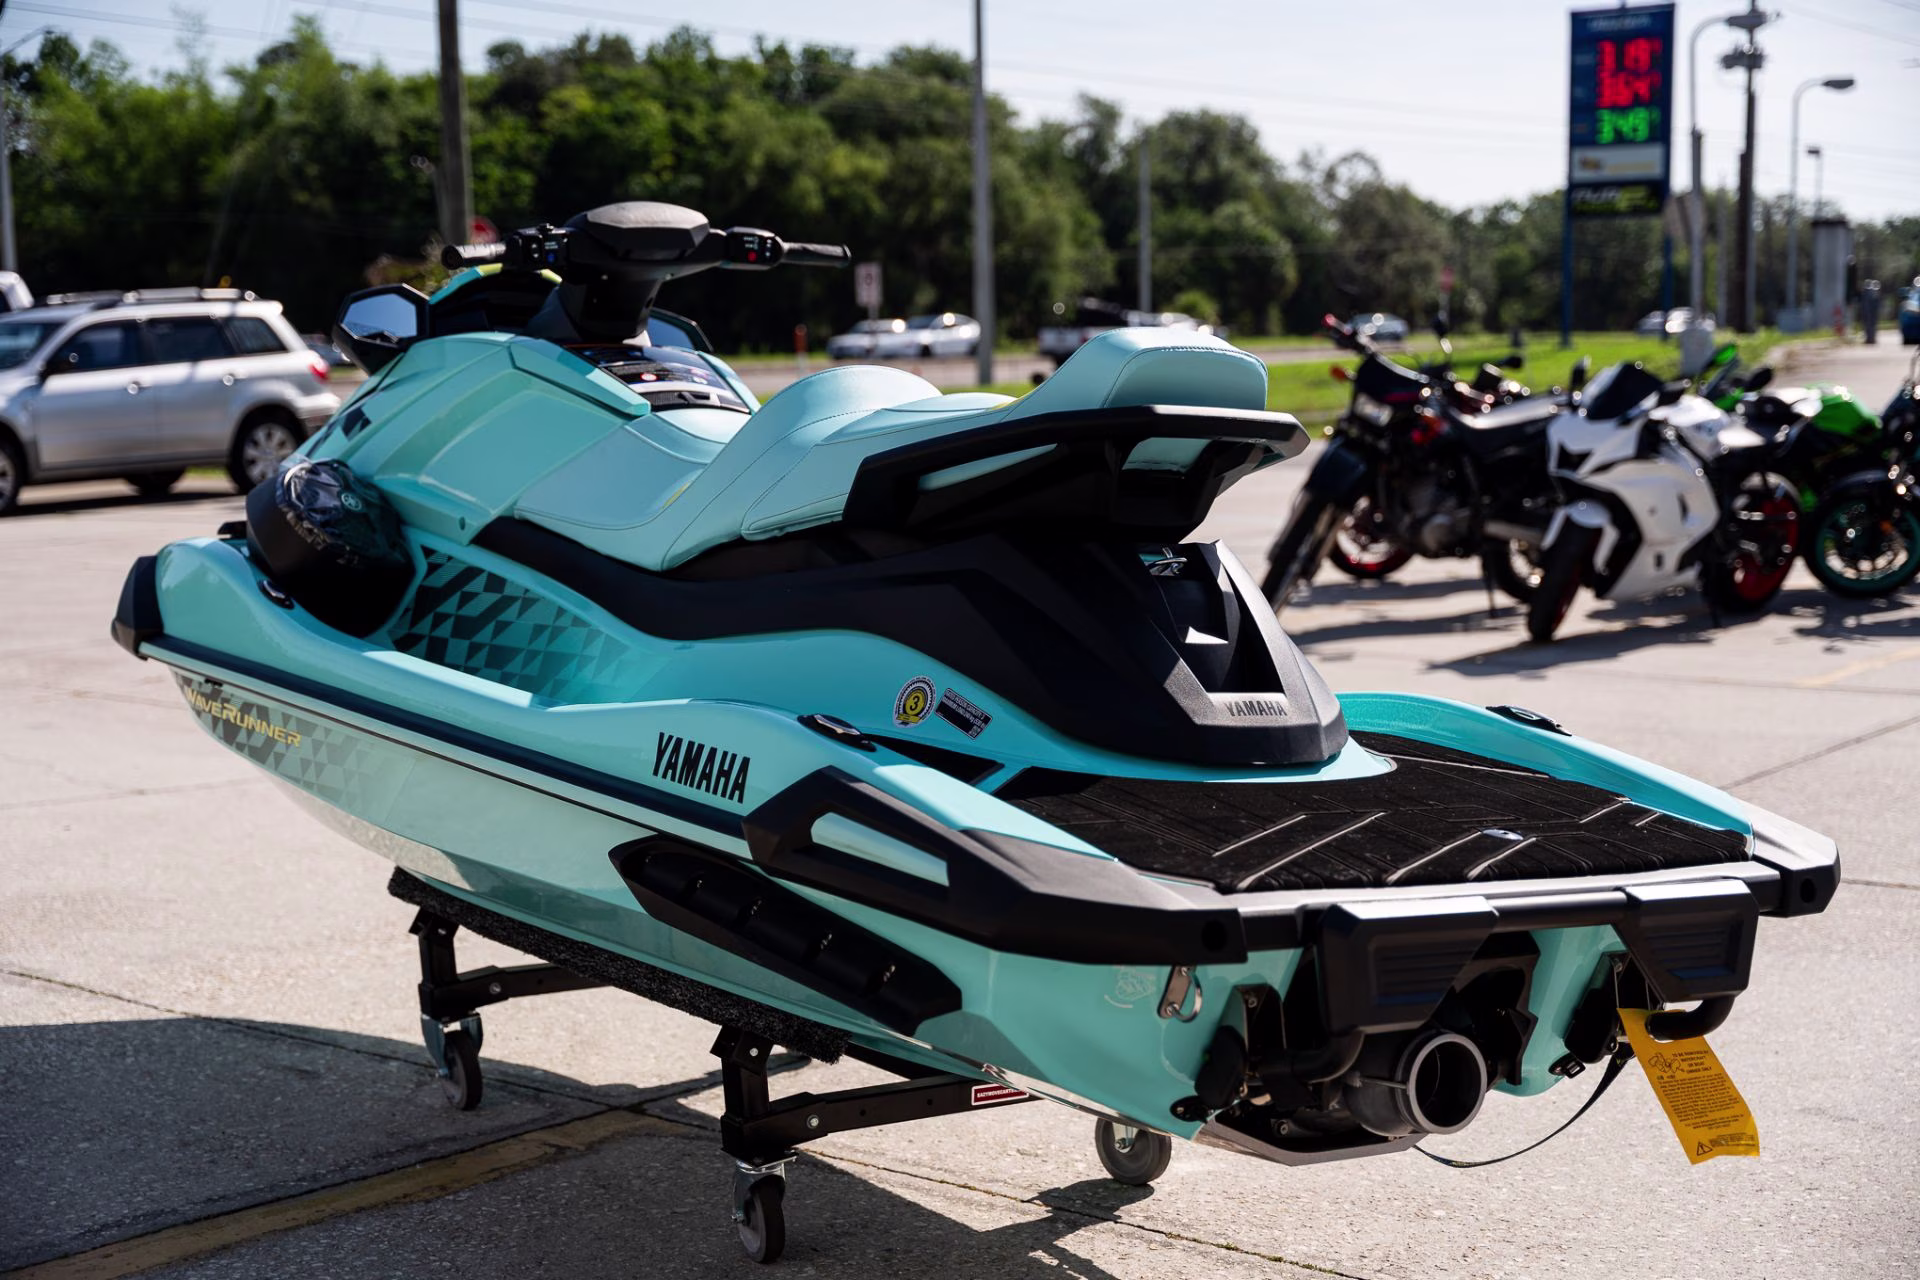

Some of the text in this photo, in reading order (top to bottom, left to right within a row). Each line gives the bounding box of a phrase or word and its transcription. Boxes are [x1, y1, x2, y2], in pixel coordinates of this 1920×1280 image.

[185, 687, 302, 747] WAVERUNNER
[909, 695, 920, 711] 3
[1224, 700, 1288, 717] YAMAHA
[652, 731, 751, 804] YAMAHA
